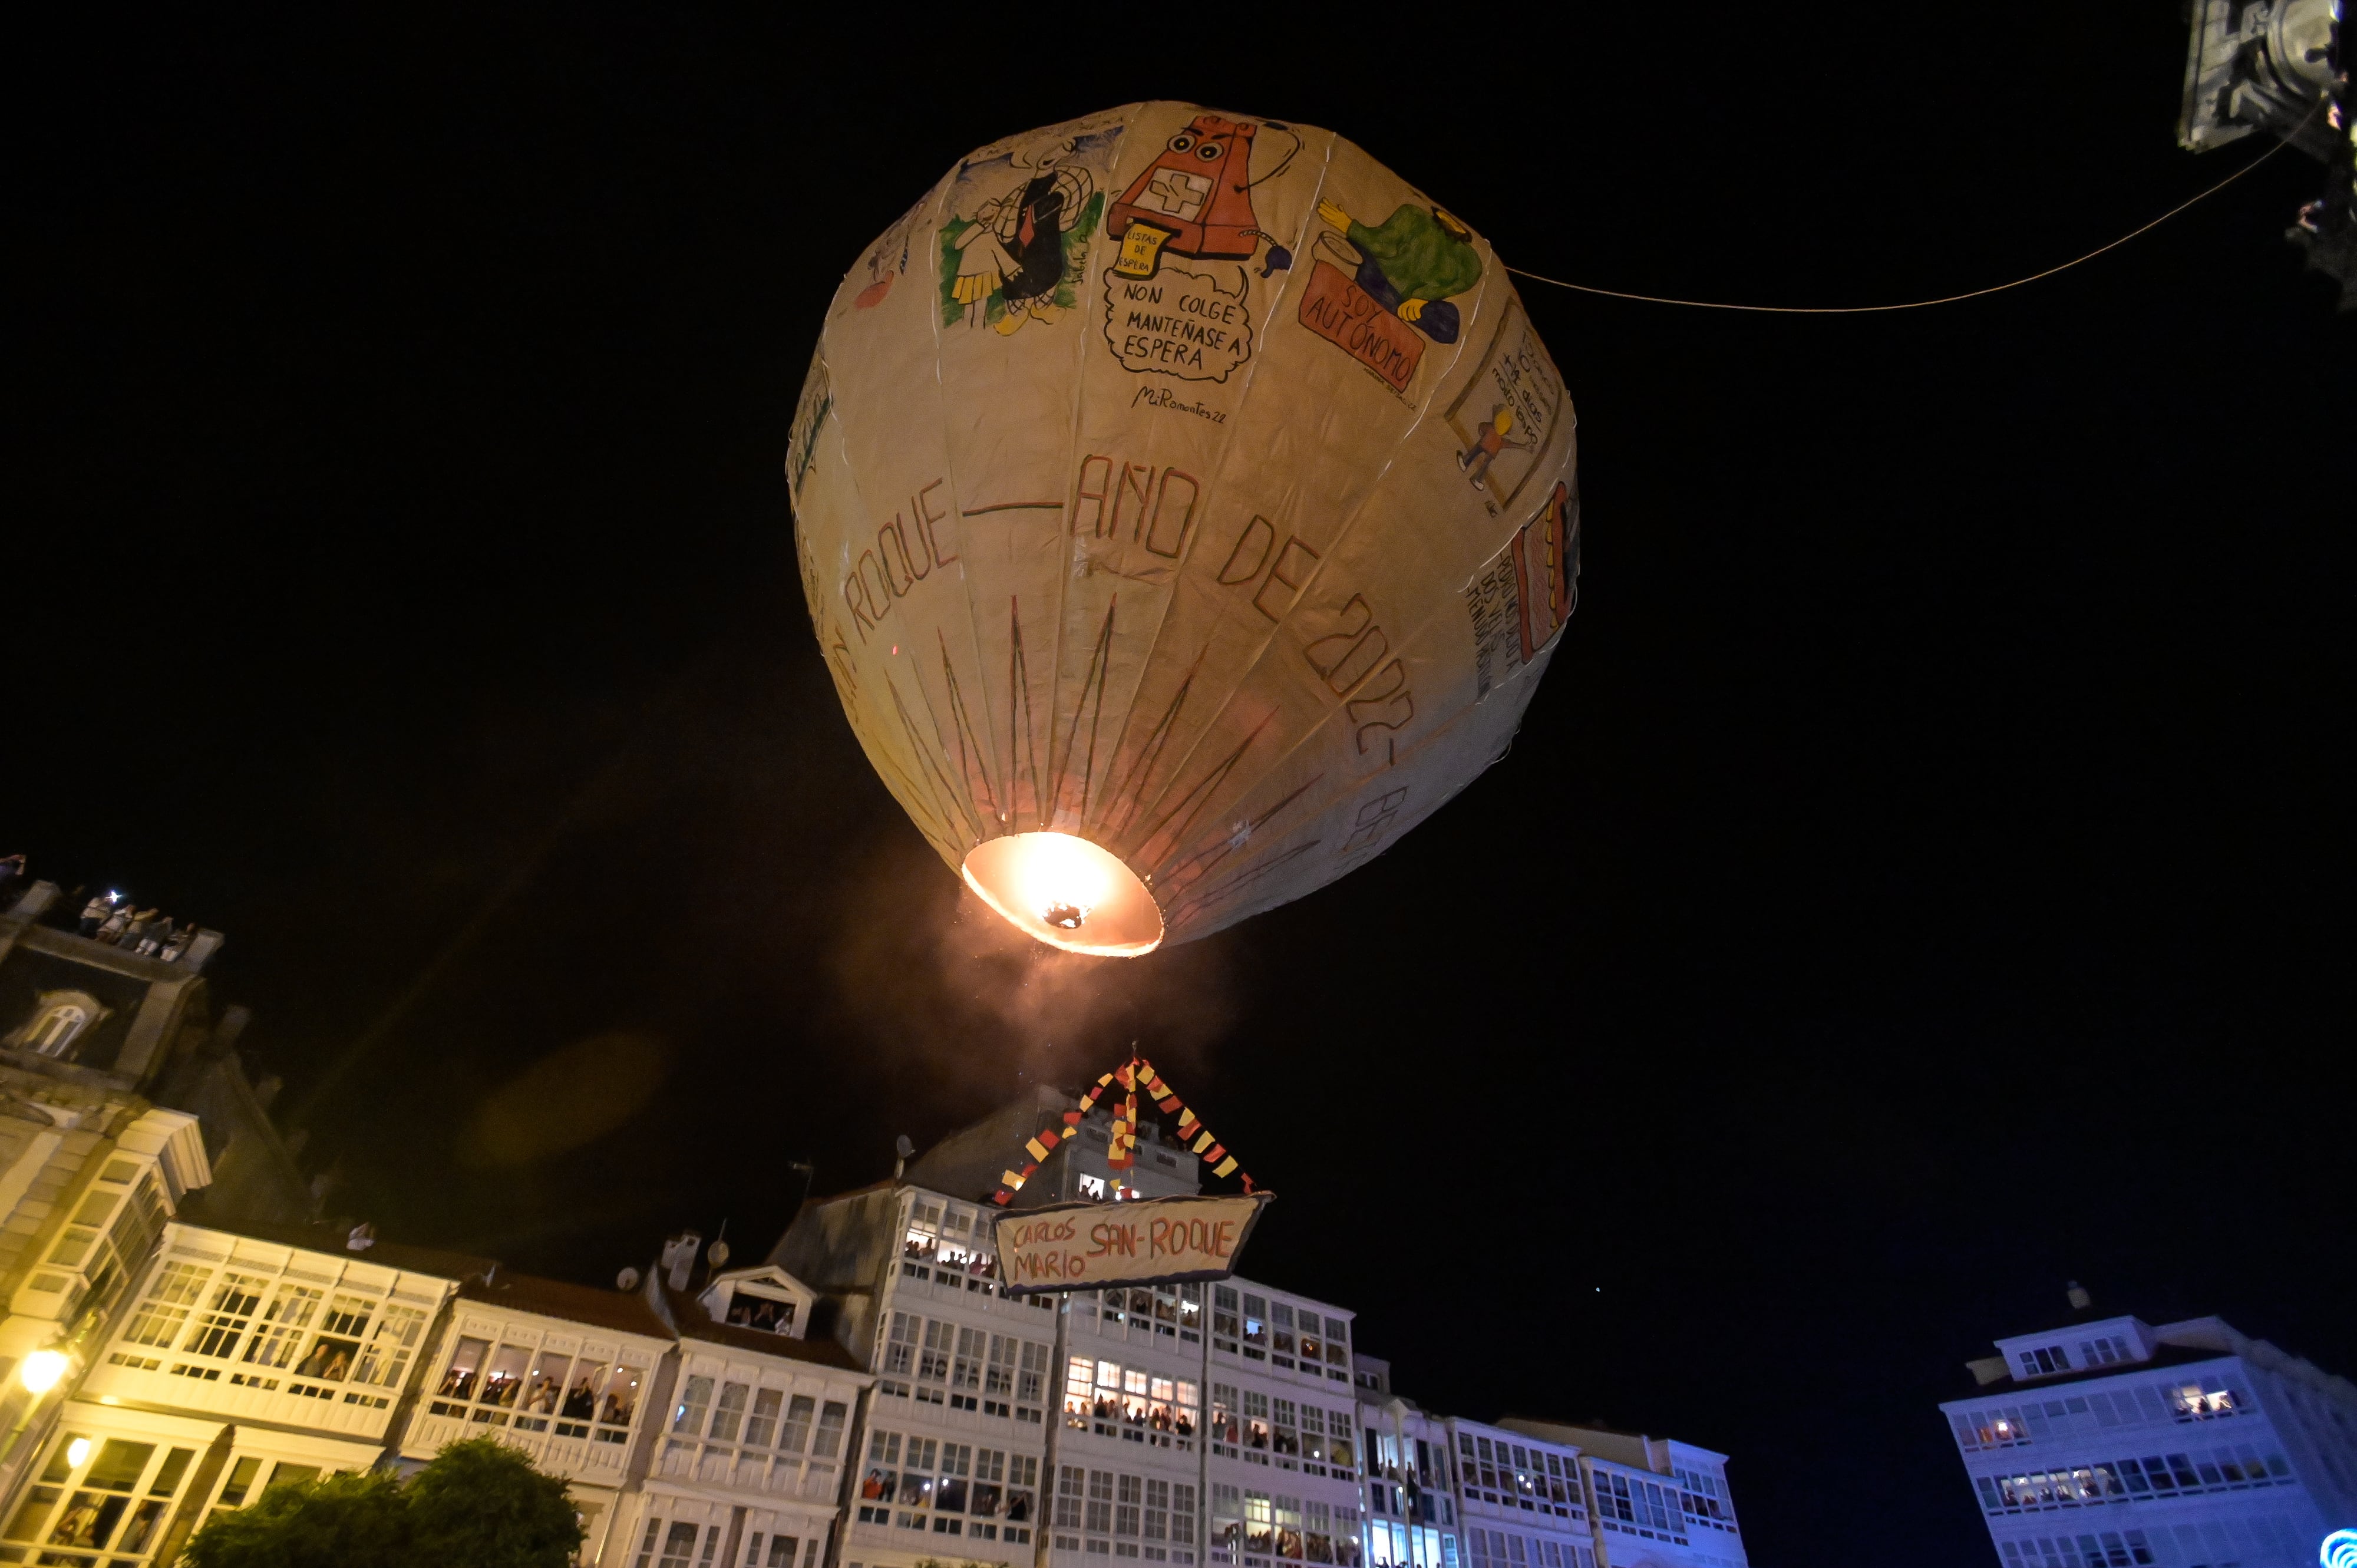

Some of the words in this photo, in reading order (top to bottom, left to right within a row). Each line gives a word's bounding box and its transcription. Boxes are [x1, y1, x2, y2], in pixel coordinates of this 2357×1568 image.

[1127, 232, 1157, 245] LISTAS
[1134, 245, 1146, 255] DE
[1118, 257, 1149, 272] ESPERA
[1124, 283, 1163, 304] NON
[1179, 295, 1236, 325] COLGE
[1342, 285, 1381, 322] SOY
[1127, 311, 1227, 350] MANTEÑASE
[1227, 337, 1240, 356] A
[1305, 296, 1412, 382] AUTÓNOMO
[1124, 335, 1202, 370] ESPERA
[1481, 571, 1499, 604] DOS
[844, 477, 959, 646] ROQUE
[1069, 454, 1200, 559] AÑO
[1216, 514, 1321, 625] DE
[1302, 591, 1414, 756] 2022
[1013, 1216, 1077, 1249] CARLOS
[1087, 1216, 1236, 1259] SAN-ROQUE
[1014, 1250, 1085, 1280] MARIO
